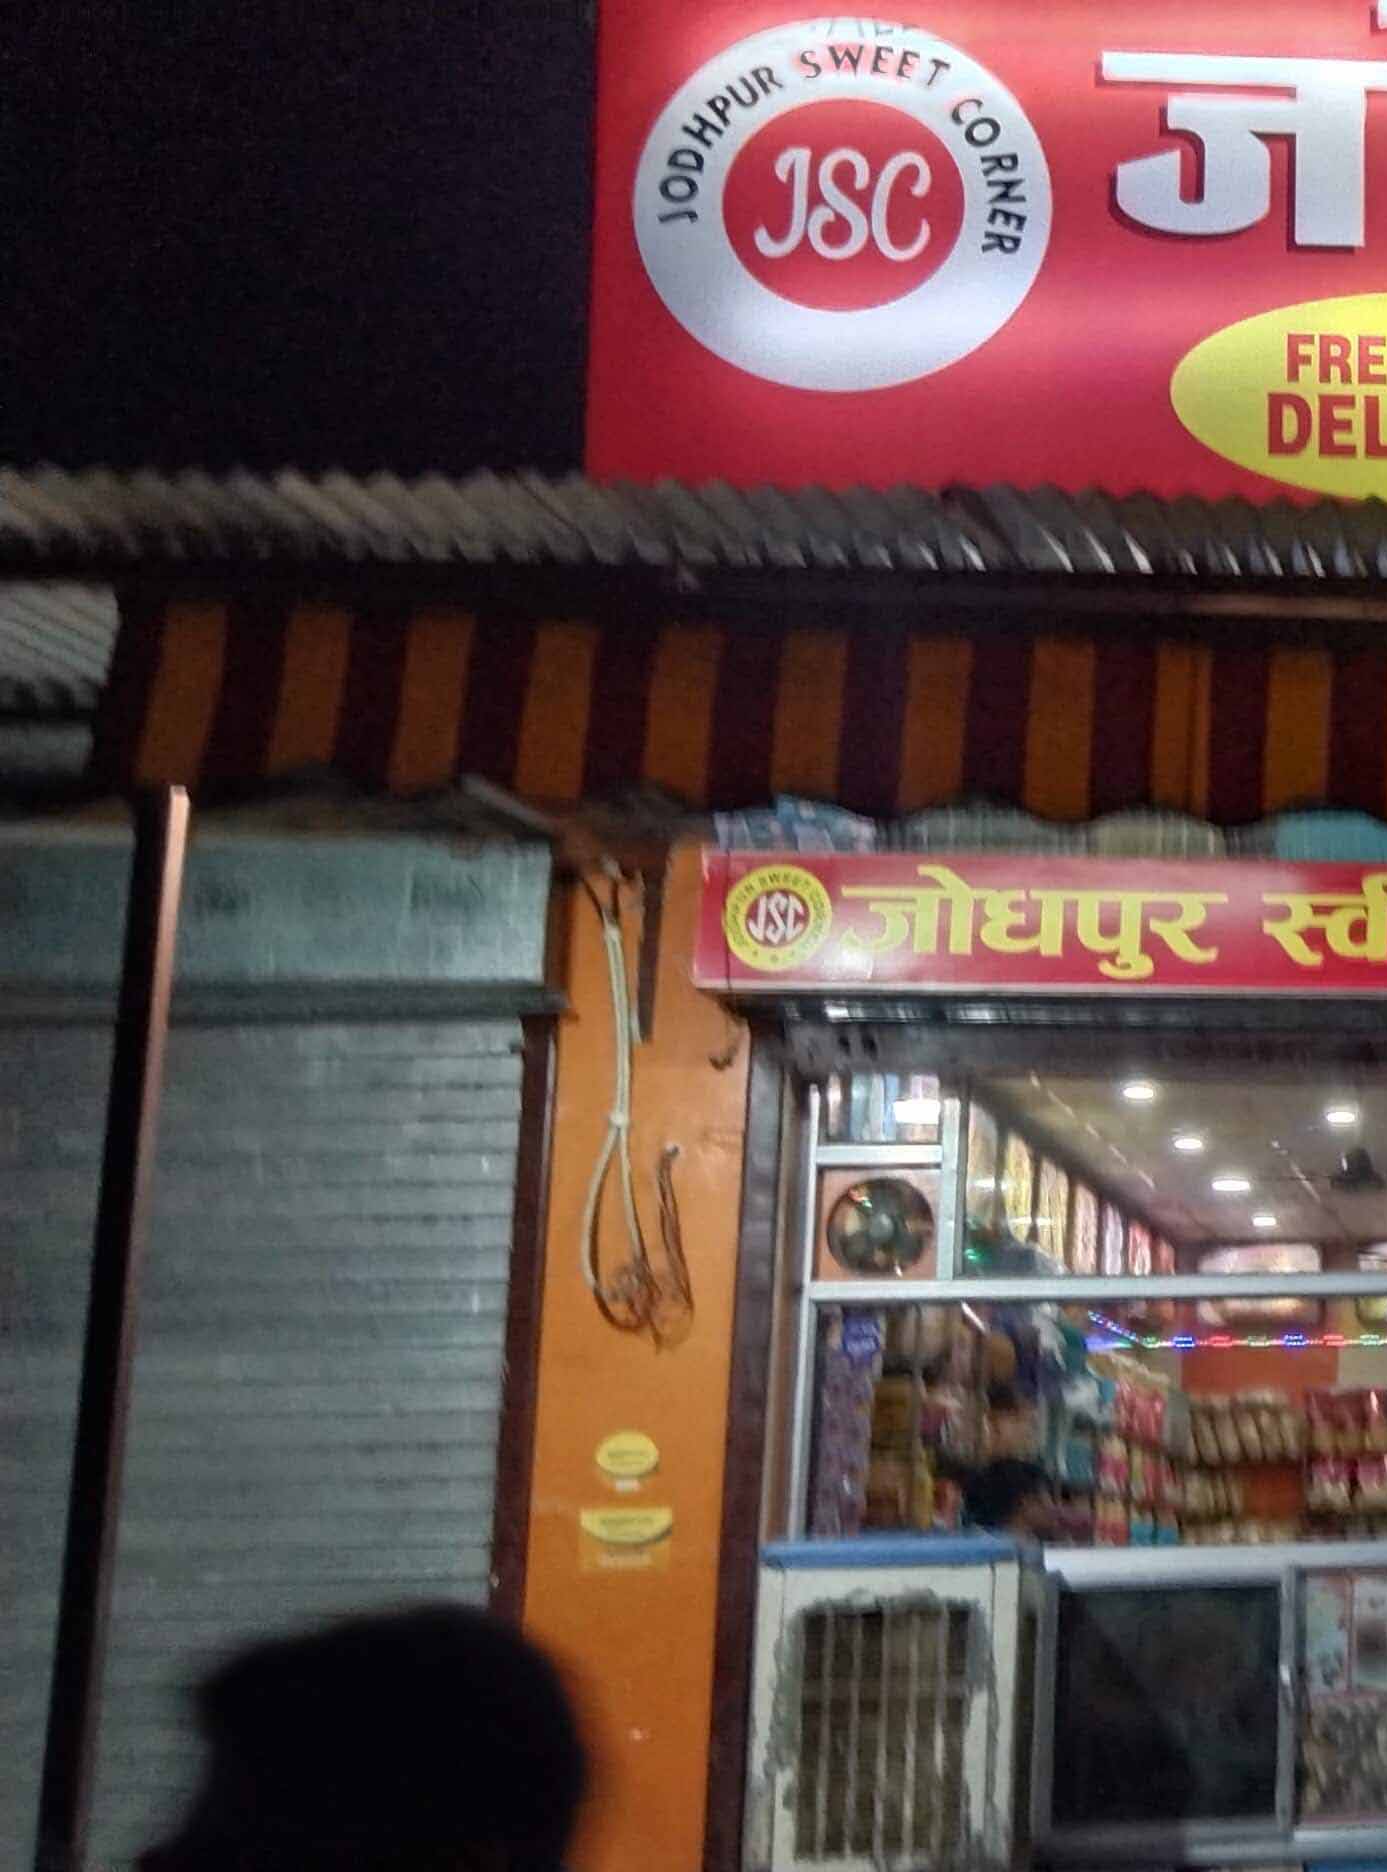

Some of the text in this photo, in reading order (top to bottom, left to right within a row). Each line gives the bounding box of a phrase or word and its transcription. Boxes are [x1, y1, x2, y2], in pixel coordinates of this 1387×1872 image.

[657, 45, 1027, 256] JODHPUR SWEET CORNER
[753, 147, 932, 262] JSC
[747, 891, 805, 945] JSC
[840, 864, 1228, 980] जोधपुर
